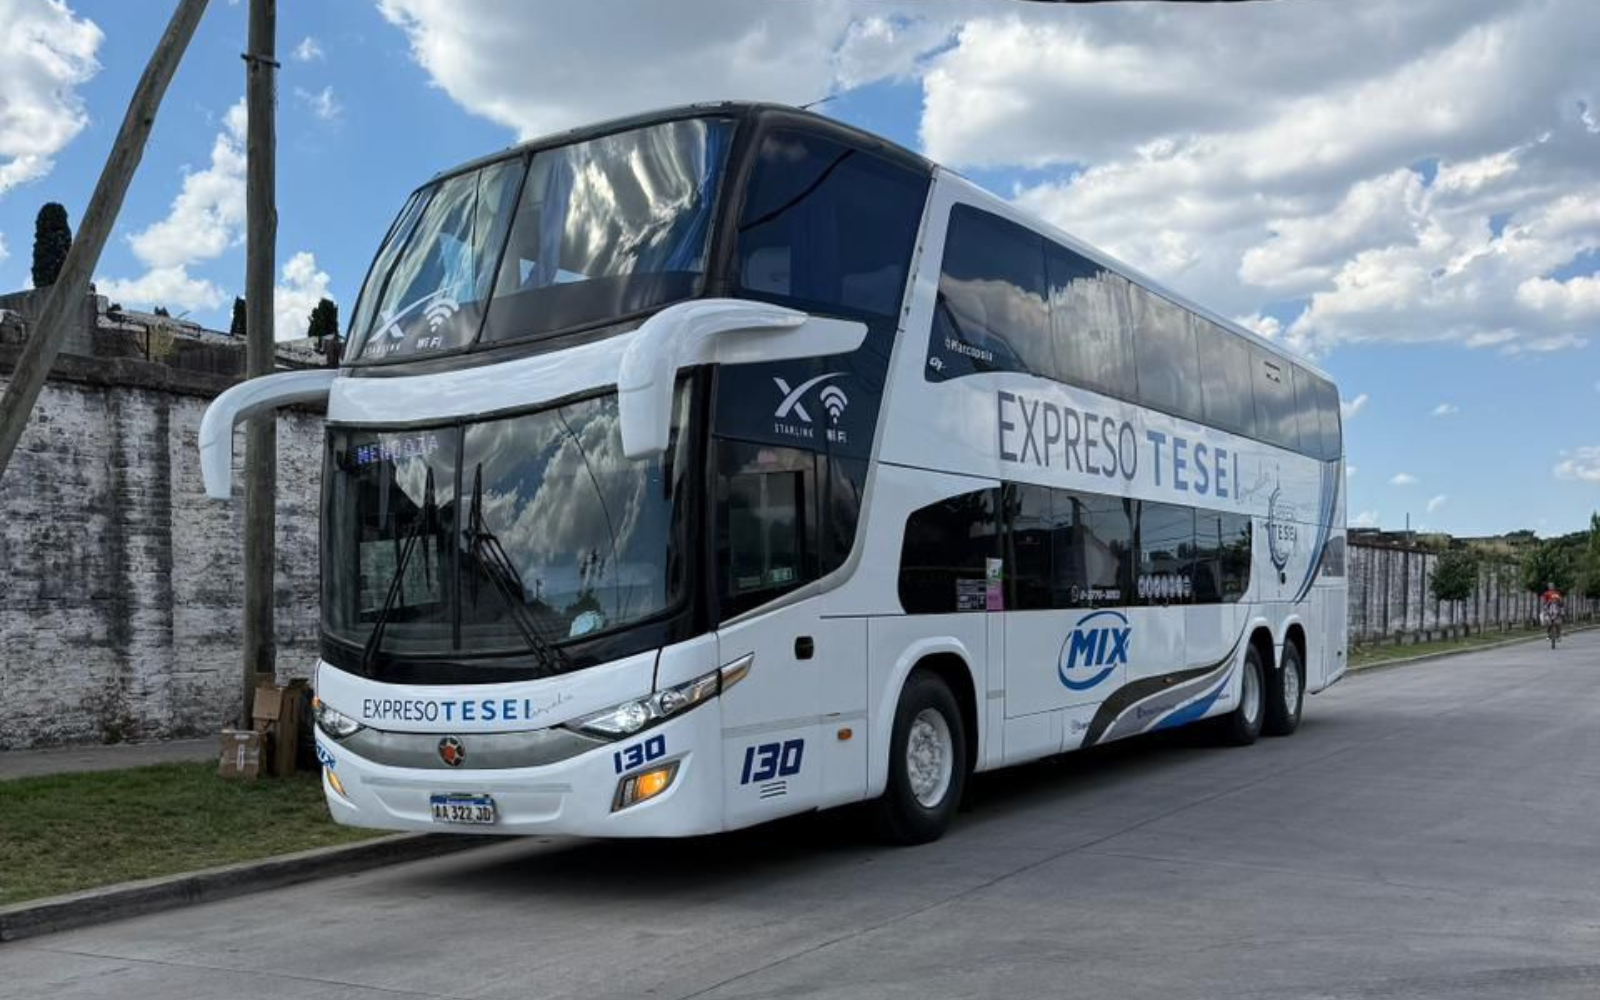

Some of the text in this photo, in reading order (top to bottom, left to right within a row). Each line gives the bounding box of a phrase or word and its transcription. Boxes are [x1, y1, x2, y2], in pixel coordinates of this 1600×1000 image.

[997, 389, 1138, 482] EXPRESO
[1146, 429, 1240, 501] TESEI
[1066, 626, 1132, 669] MIX
[363, 698, 439, 722] EXPRESO
[440, 698, 531, 722] TESEI
[613, 734, 667, 775] 130
[740, 738, 805, 785] 130
[434, 804, 449, 820] AA
[451, 805, 474, 820] 322
